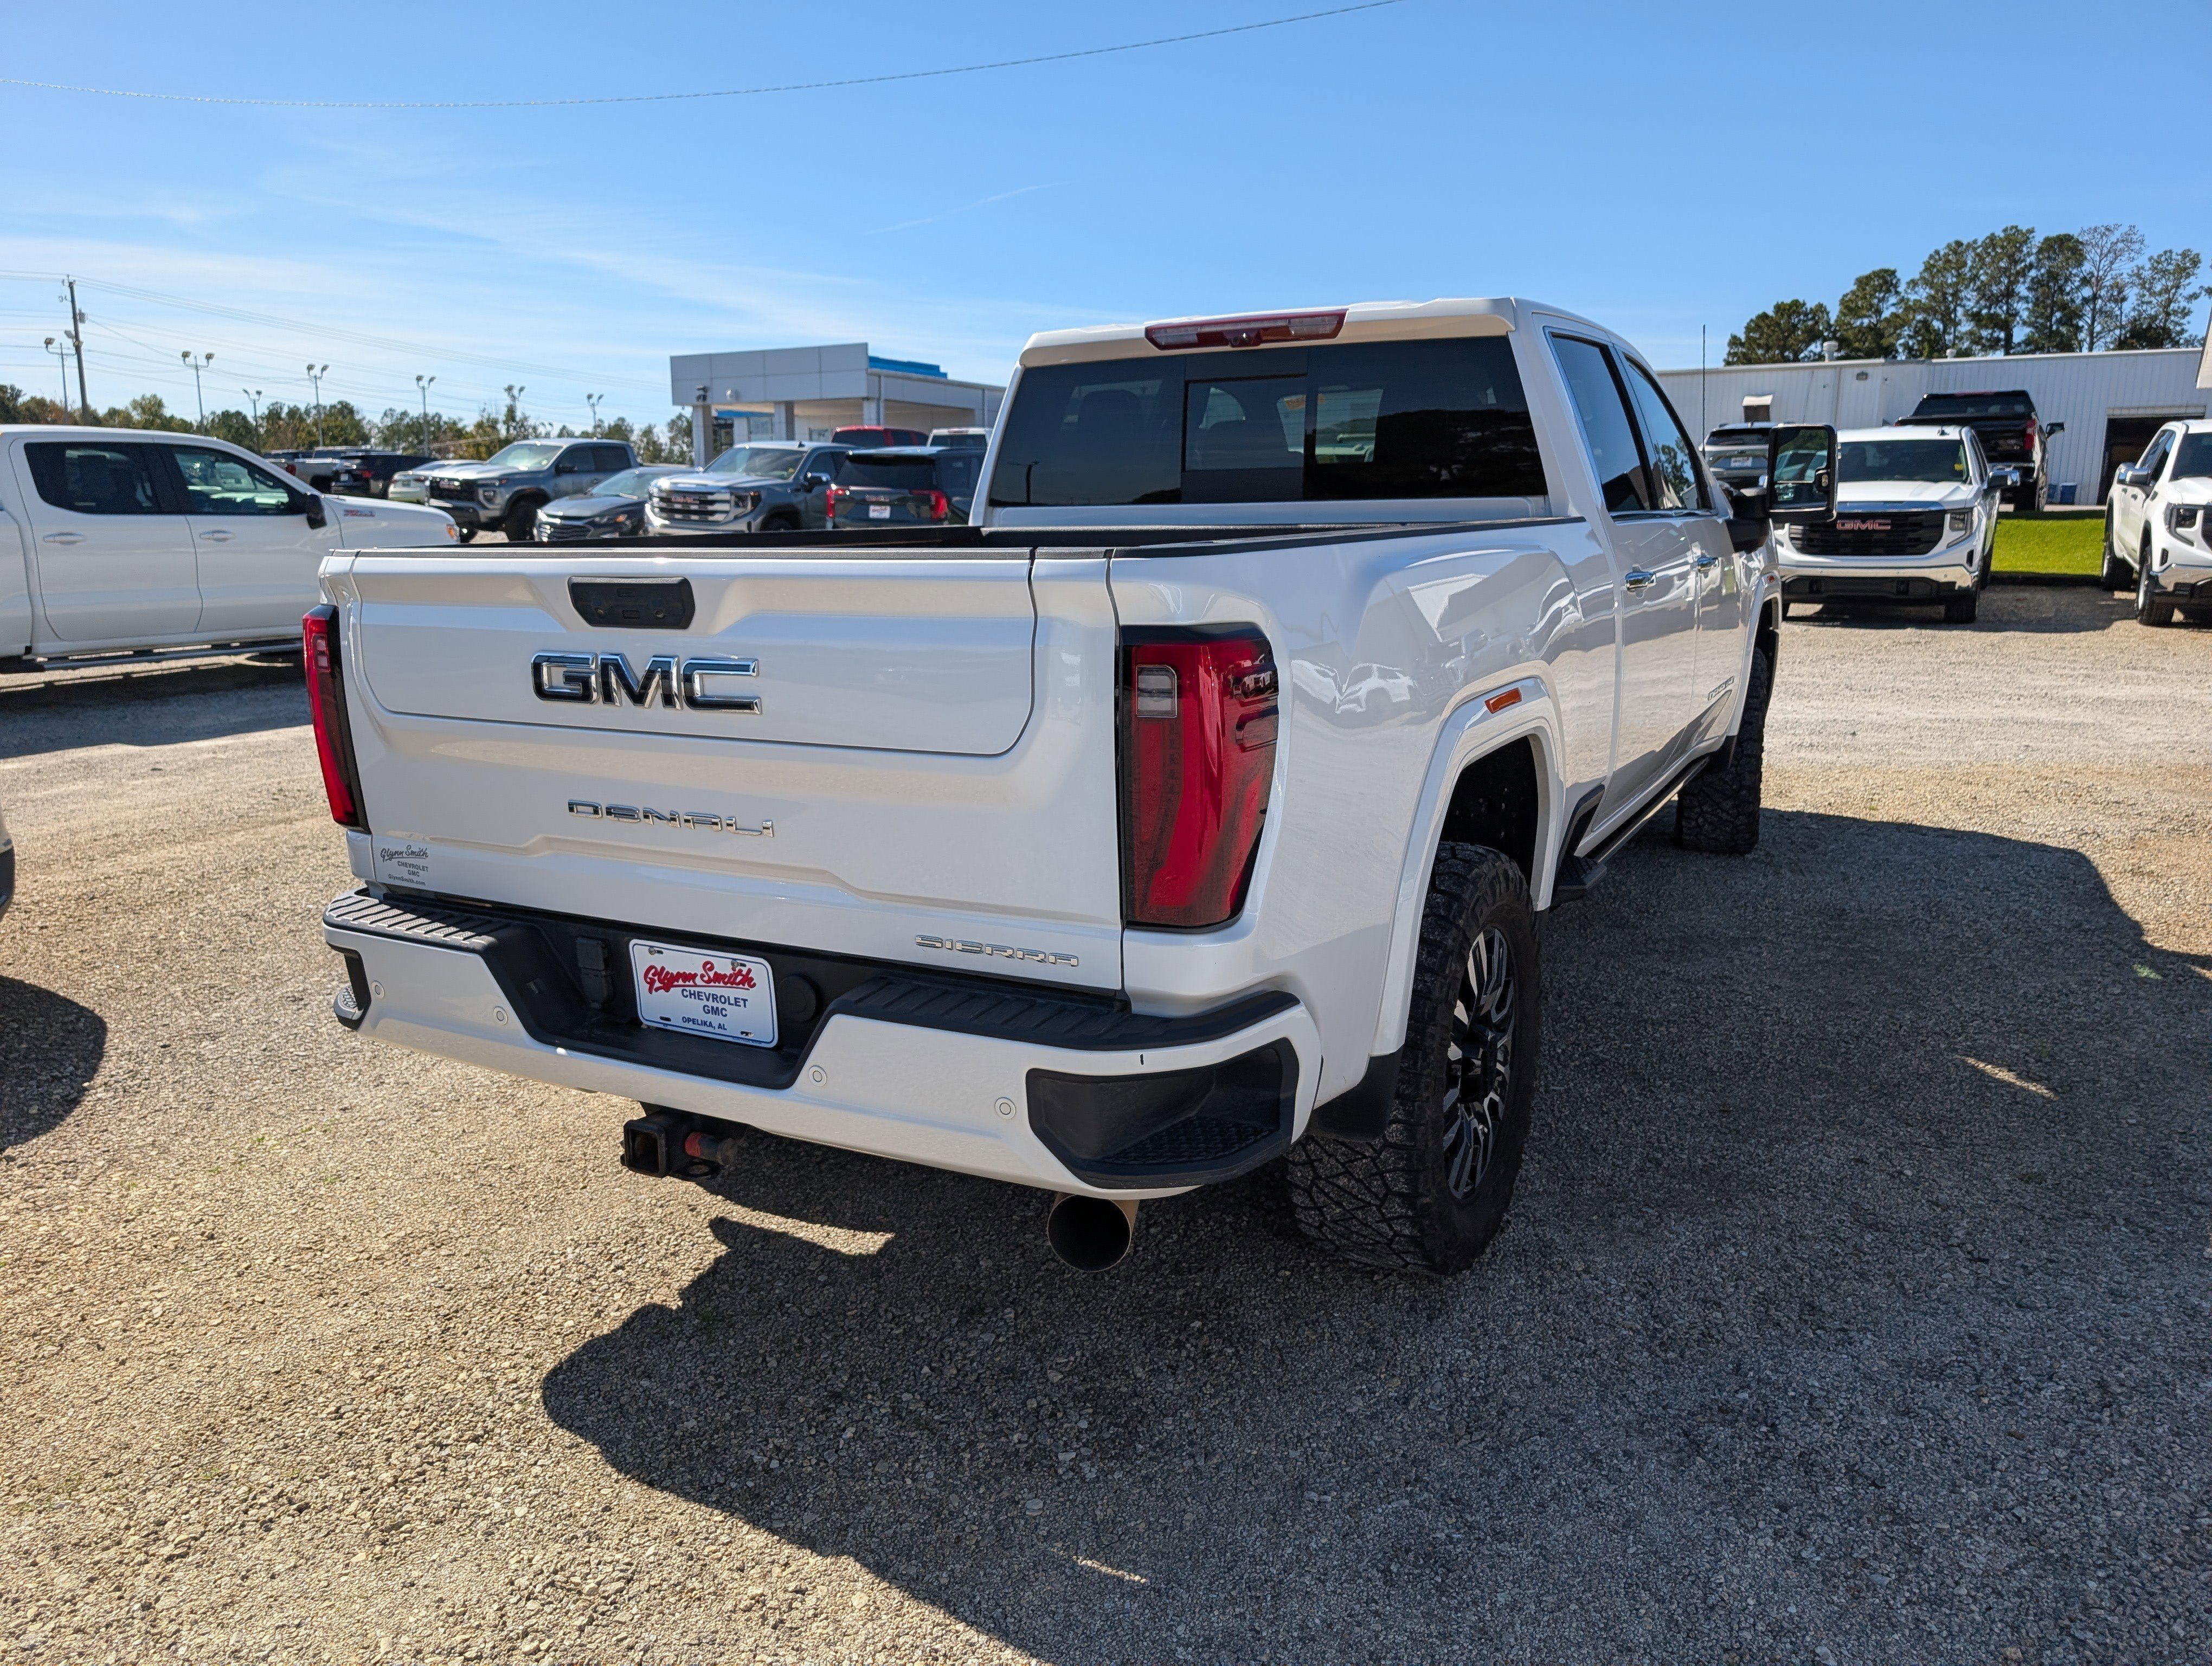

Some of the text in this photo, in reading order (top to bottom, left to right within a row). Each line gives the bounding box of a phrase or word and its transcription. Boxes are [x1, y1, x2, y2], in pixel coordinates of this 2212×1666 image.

[1836, 519, 1892, 530] GMC
[531, 651, 762, 715] GMC
[568, 799, 775, 837] DENALI
[381, 844, 429, 863] Glynn Smith
[397, 861, 429, 873] CHEVROLET
[408, 869, 420, 877] GMC
[388, 873, 426, 886] GlynnSmith.com
[915, 934, 1079, 967] SIERRA
[644, 960, 757, 995] Glynn Smith
[681, 988, 749, 1008] CHEVROLET
[703, 1004, 728, 1017] GMC
[681, 1016, 728, 1031] OPELIKA, AL
